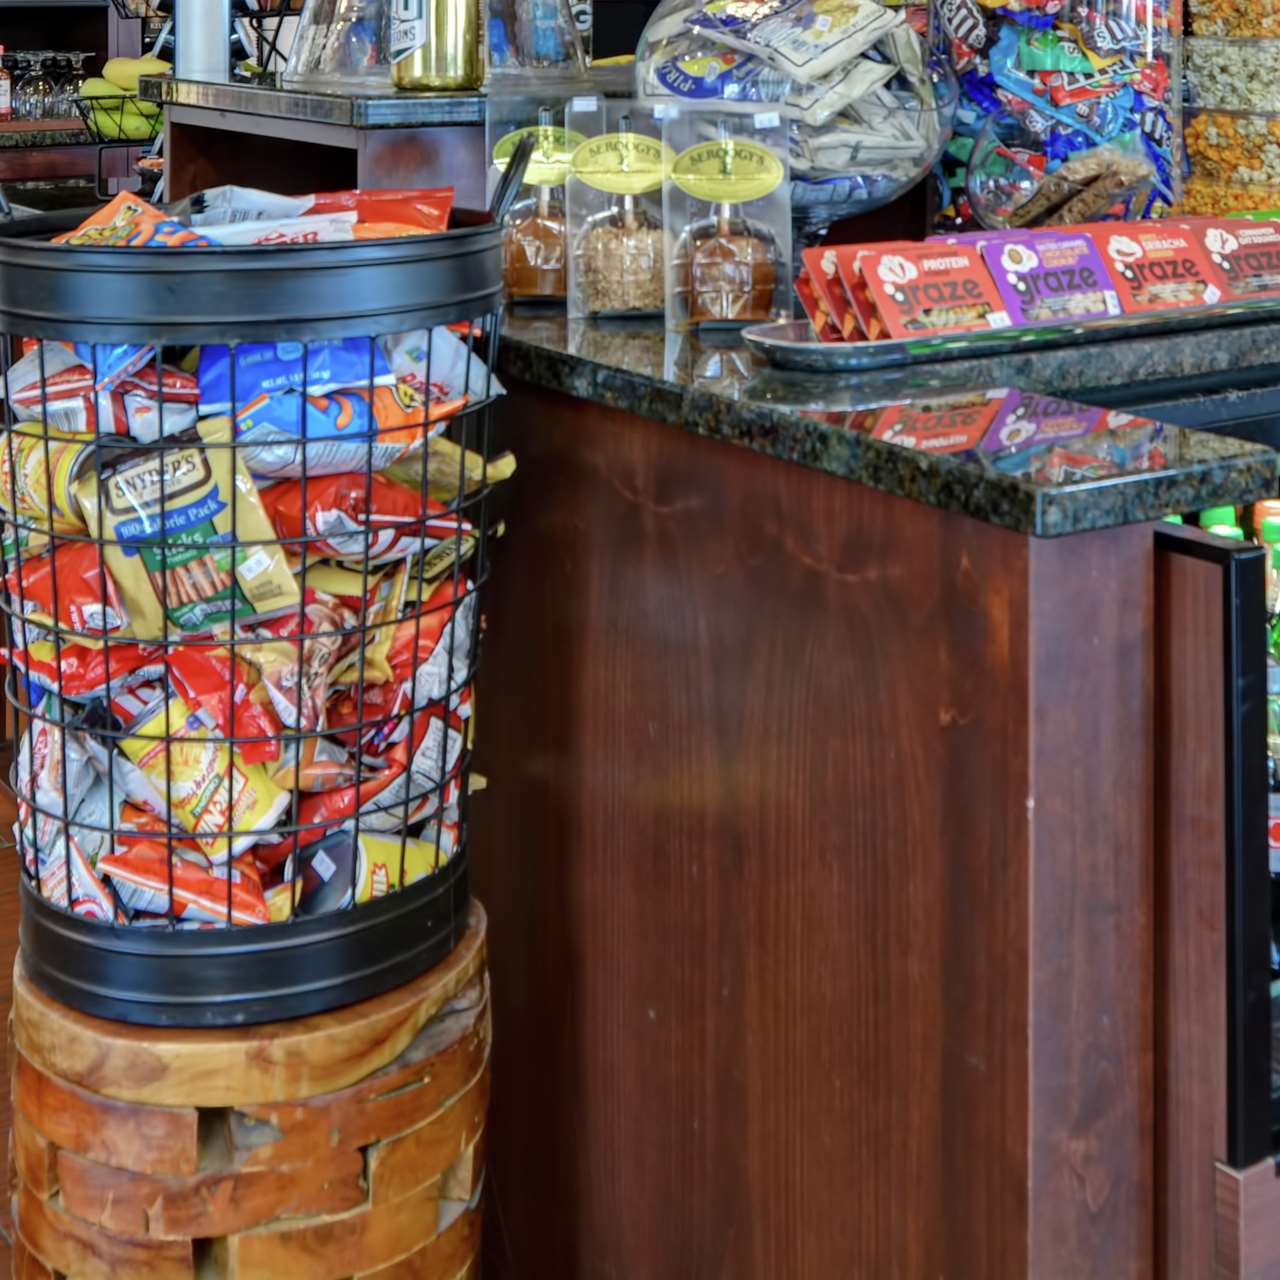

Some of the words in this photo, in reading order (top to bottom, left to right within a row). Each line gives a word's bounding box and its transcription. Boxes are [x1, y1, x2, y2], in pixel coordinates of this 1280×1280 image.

[922, 256, 970, 271] PROTEIN
[1122, 258, 1201, 291] graze
[889, 276, 985, 315] graze
[1014, 267, 1099, 307] graze
[189, 501, 219, 521] Pack
